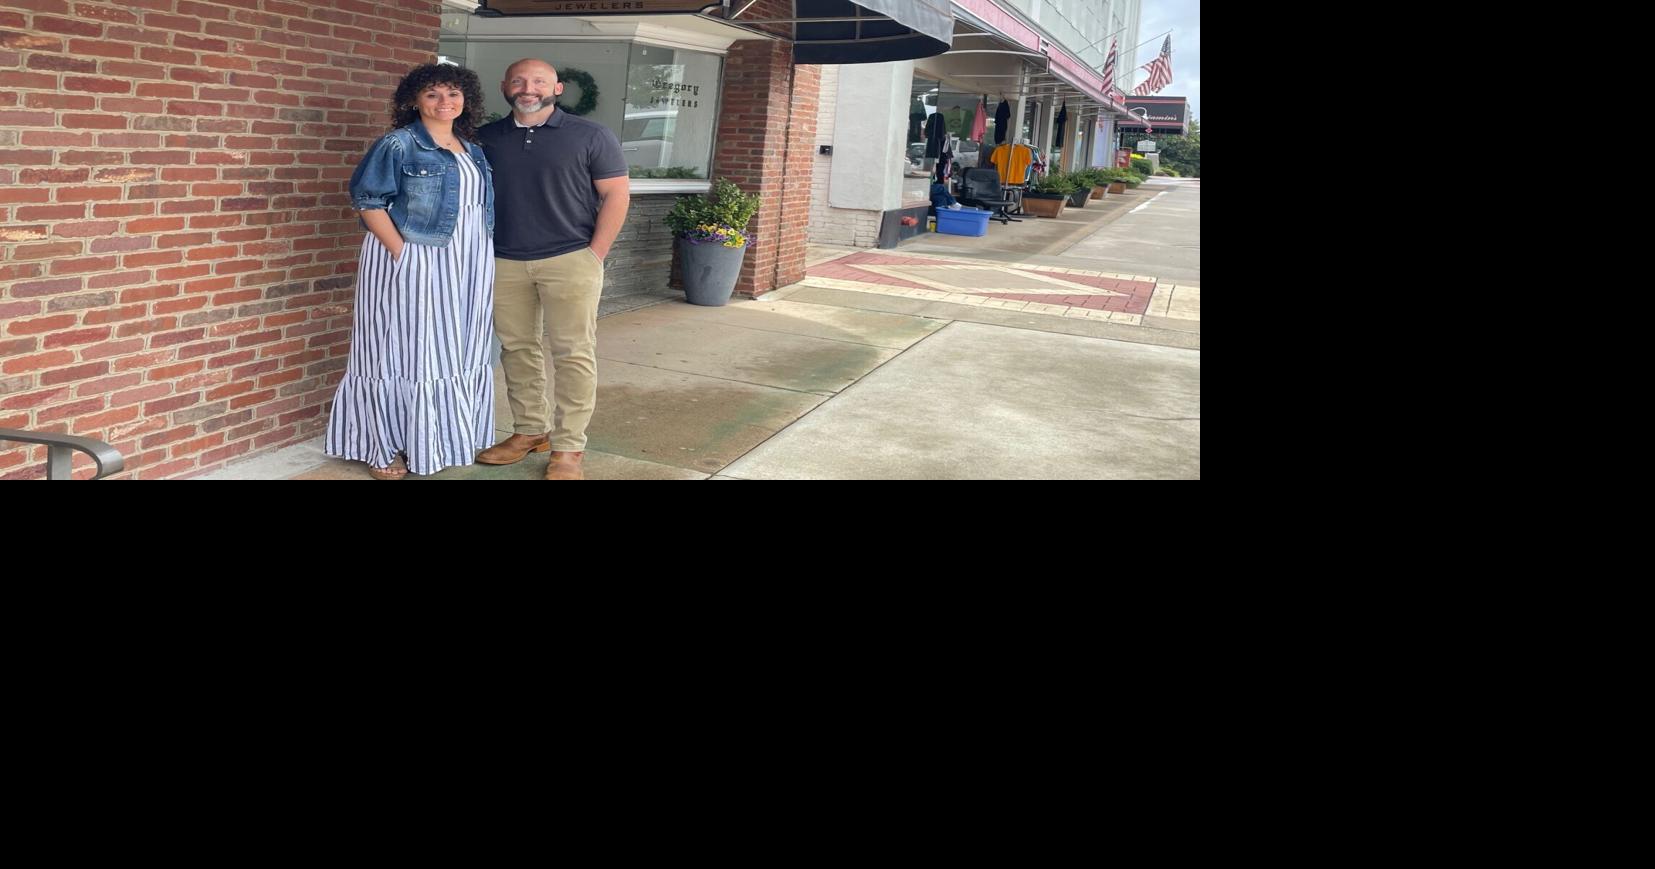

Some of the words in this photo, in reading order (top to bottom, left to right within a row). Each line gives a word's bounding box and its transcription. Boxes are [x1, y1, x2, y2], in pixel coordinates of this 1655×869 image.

[553, 1, 644, 11] JEWELERS
[651, 79, 699, 96] Gregory
[650, 96, 698, 108] JEWELERS
